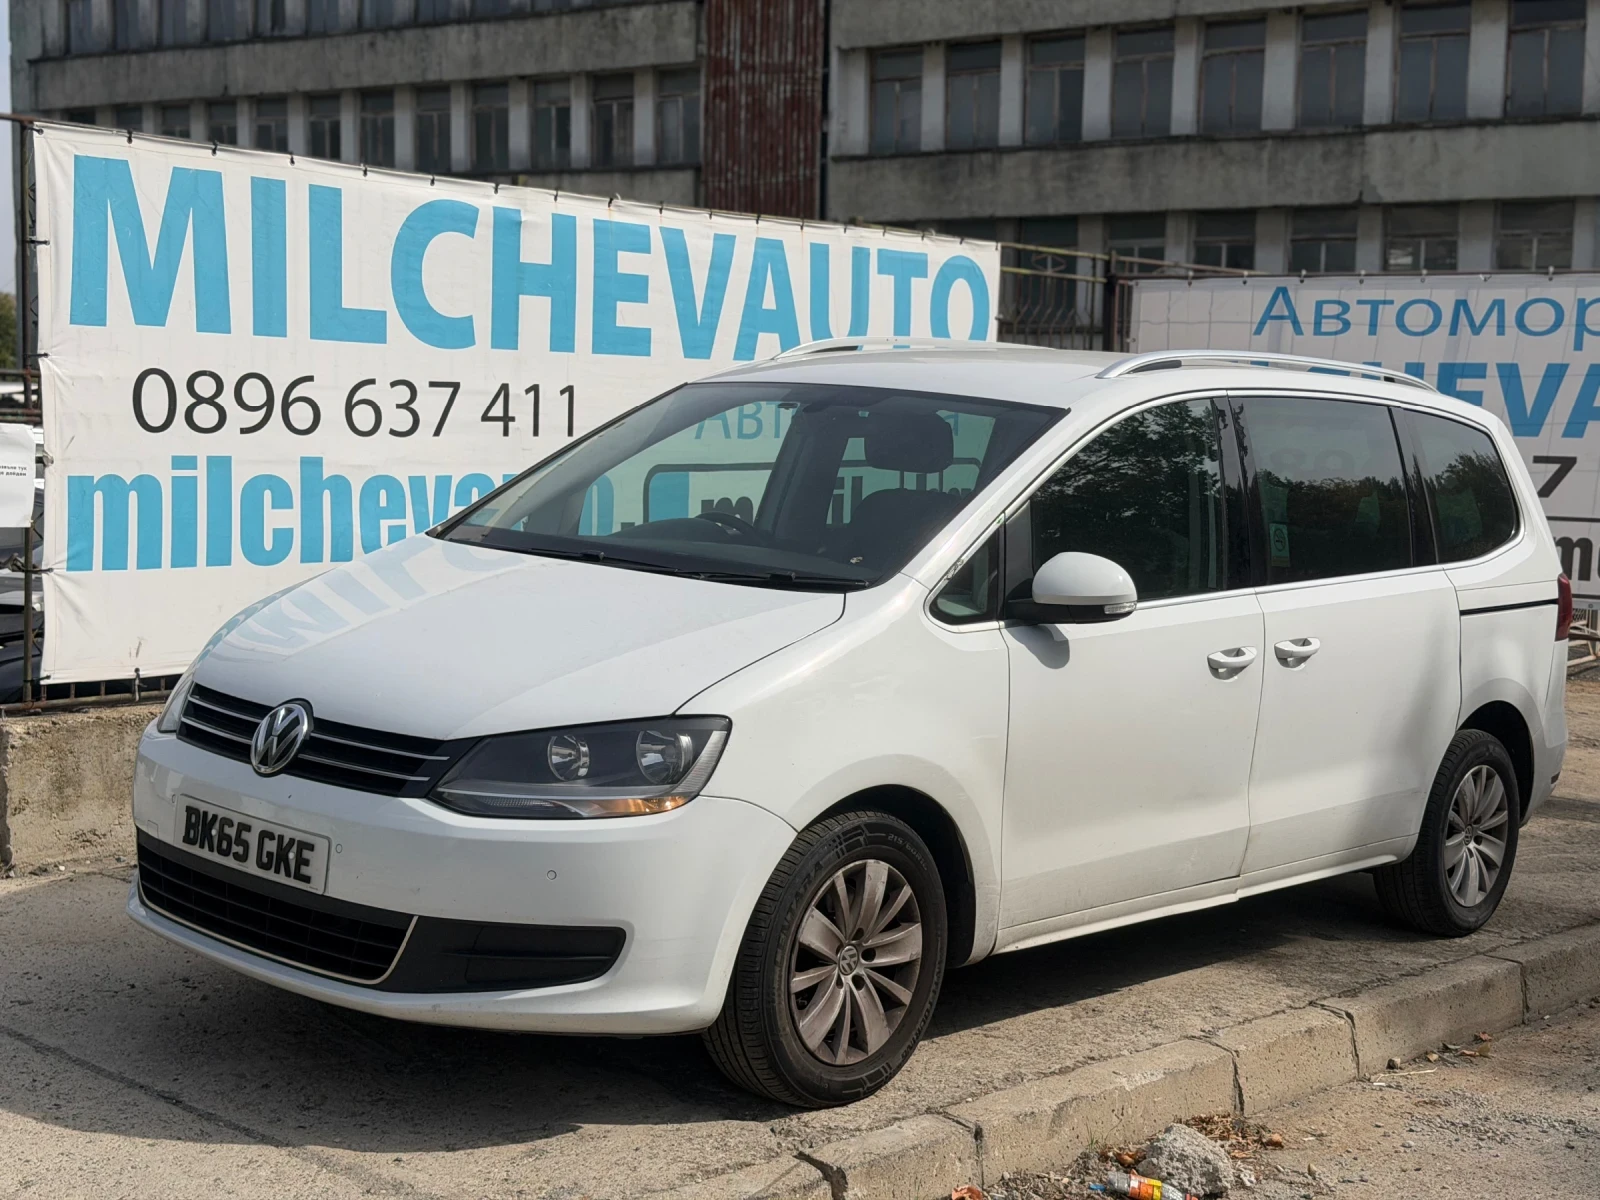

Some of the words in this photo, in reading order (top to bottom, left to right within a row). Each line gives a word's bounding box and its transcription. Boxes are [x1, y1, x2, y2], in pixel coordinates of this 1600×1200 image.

[69, 154, 990, 362] MILCHEVAUTO
[131, 367, 322, 437] 0896
[344, 378, 461, 438] 637
[481, 382, 577, 438] 411
[182, 805, 252, 863] BK65
[257, 830, 315, 884] GKE
